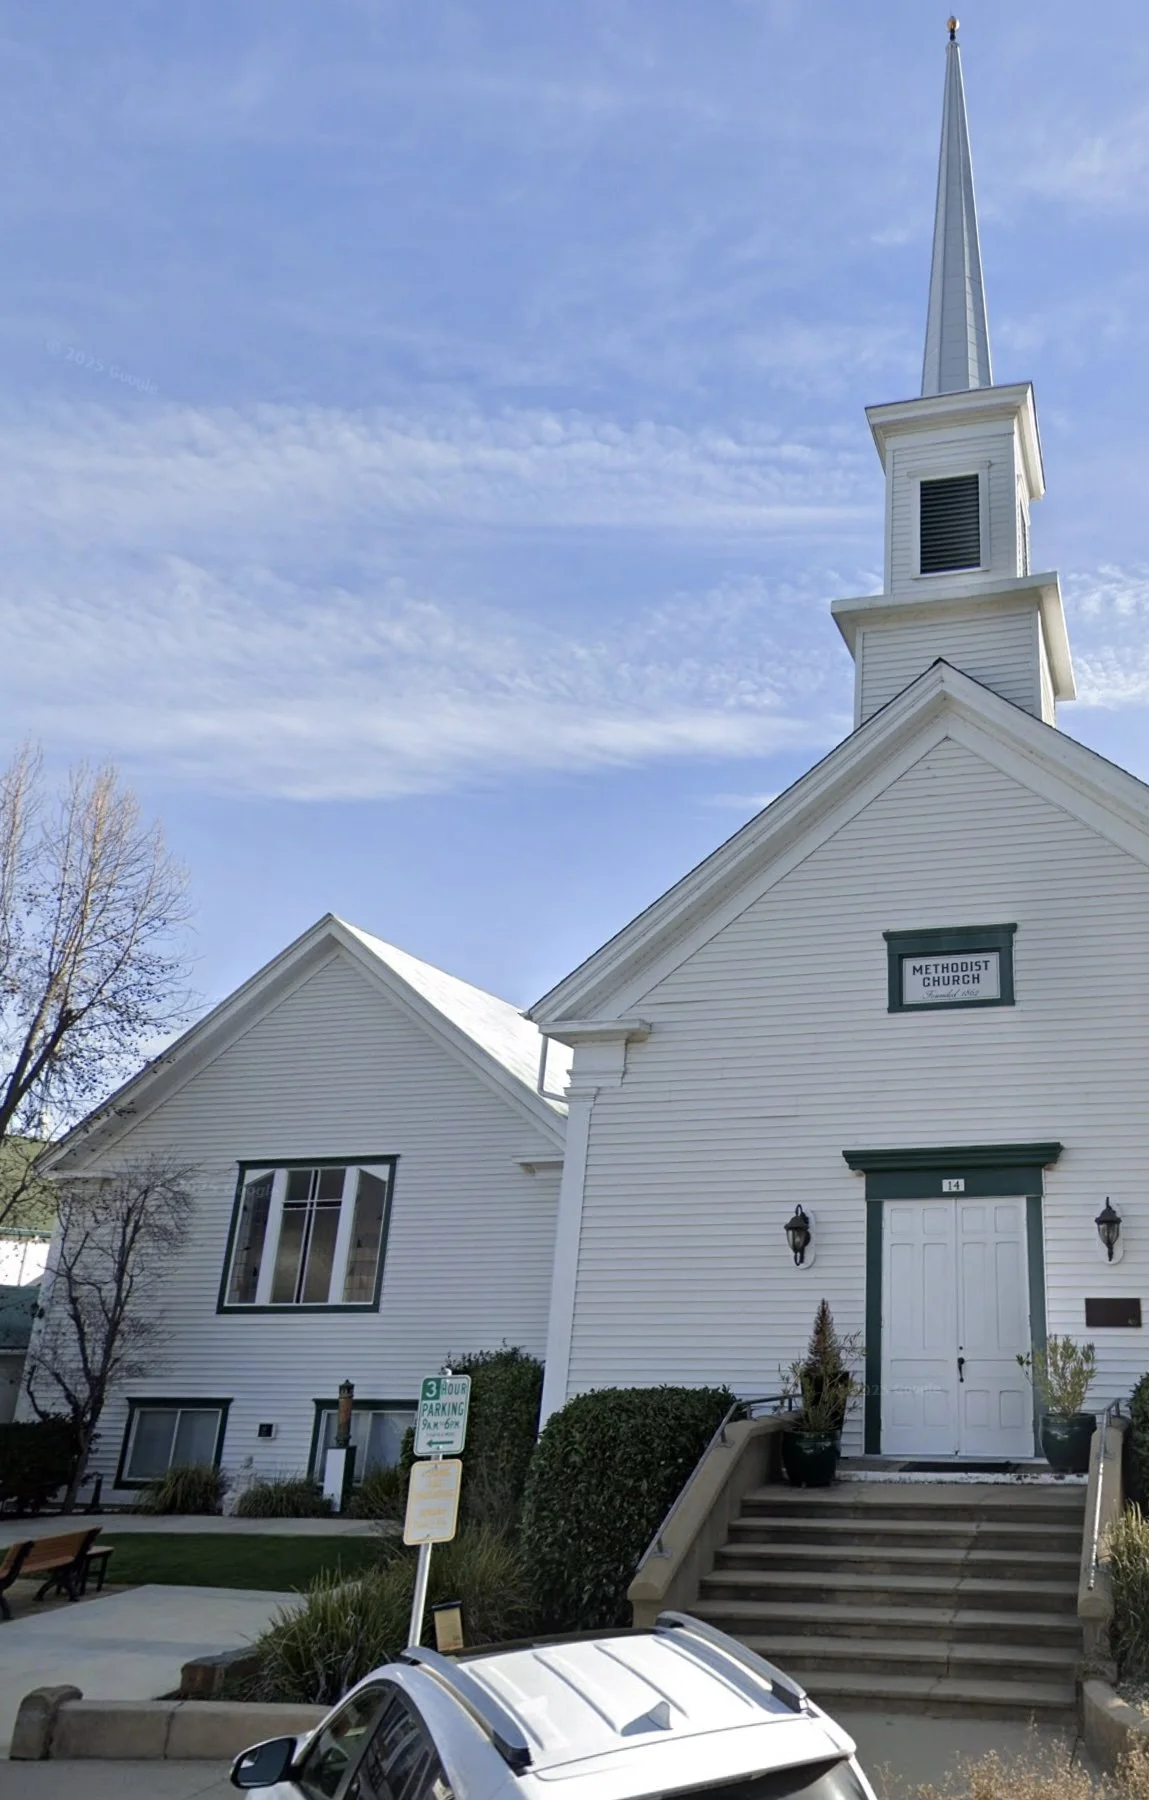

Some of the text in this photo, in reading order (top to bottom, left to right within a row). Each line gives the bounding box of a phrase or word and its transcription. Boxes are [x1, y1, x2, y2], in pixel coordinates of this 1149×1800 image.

[912, 960, 990, 976] METHODIST
[922, 973, 981, 988] CHURCH
[948, 1180, 960, 1190] 14
[425, 1380, 468, 1398] 3 HOUR
[421, 1401, 465, 1417] PARKING
